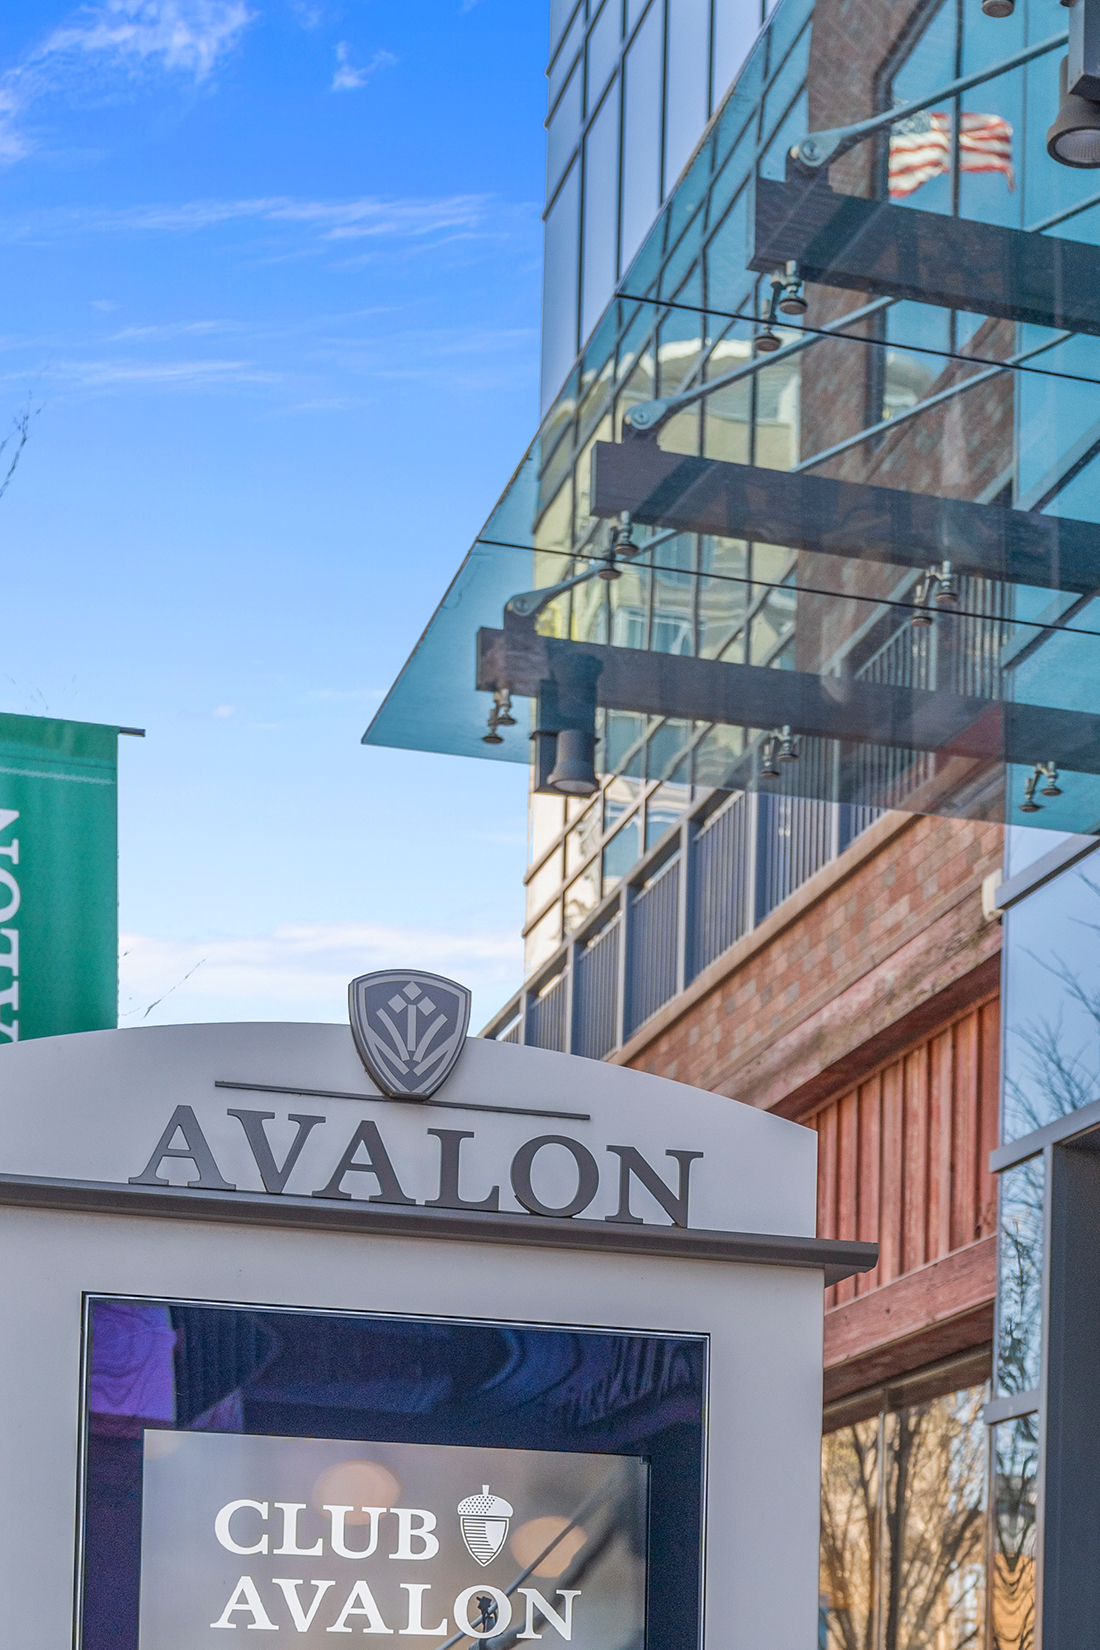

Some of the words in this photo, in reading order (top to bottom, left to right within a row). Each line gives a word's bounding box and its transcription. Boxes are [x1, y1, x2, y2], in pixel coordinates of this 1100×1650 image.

[128, 1104, 704, 1229] AVALON
[214, 1499, 440, 1561] CLUB
[209, 1575, 582, 1642] AVALON
